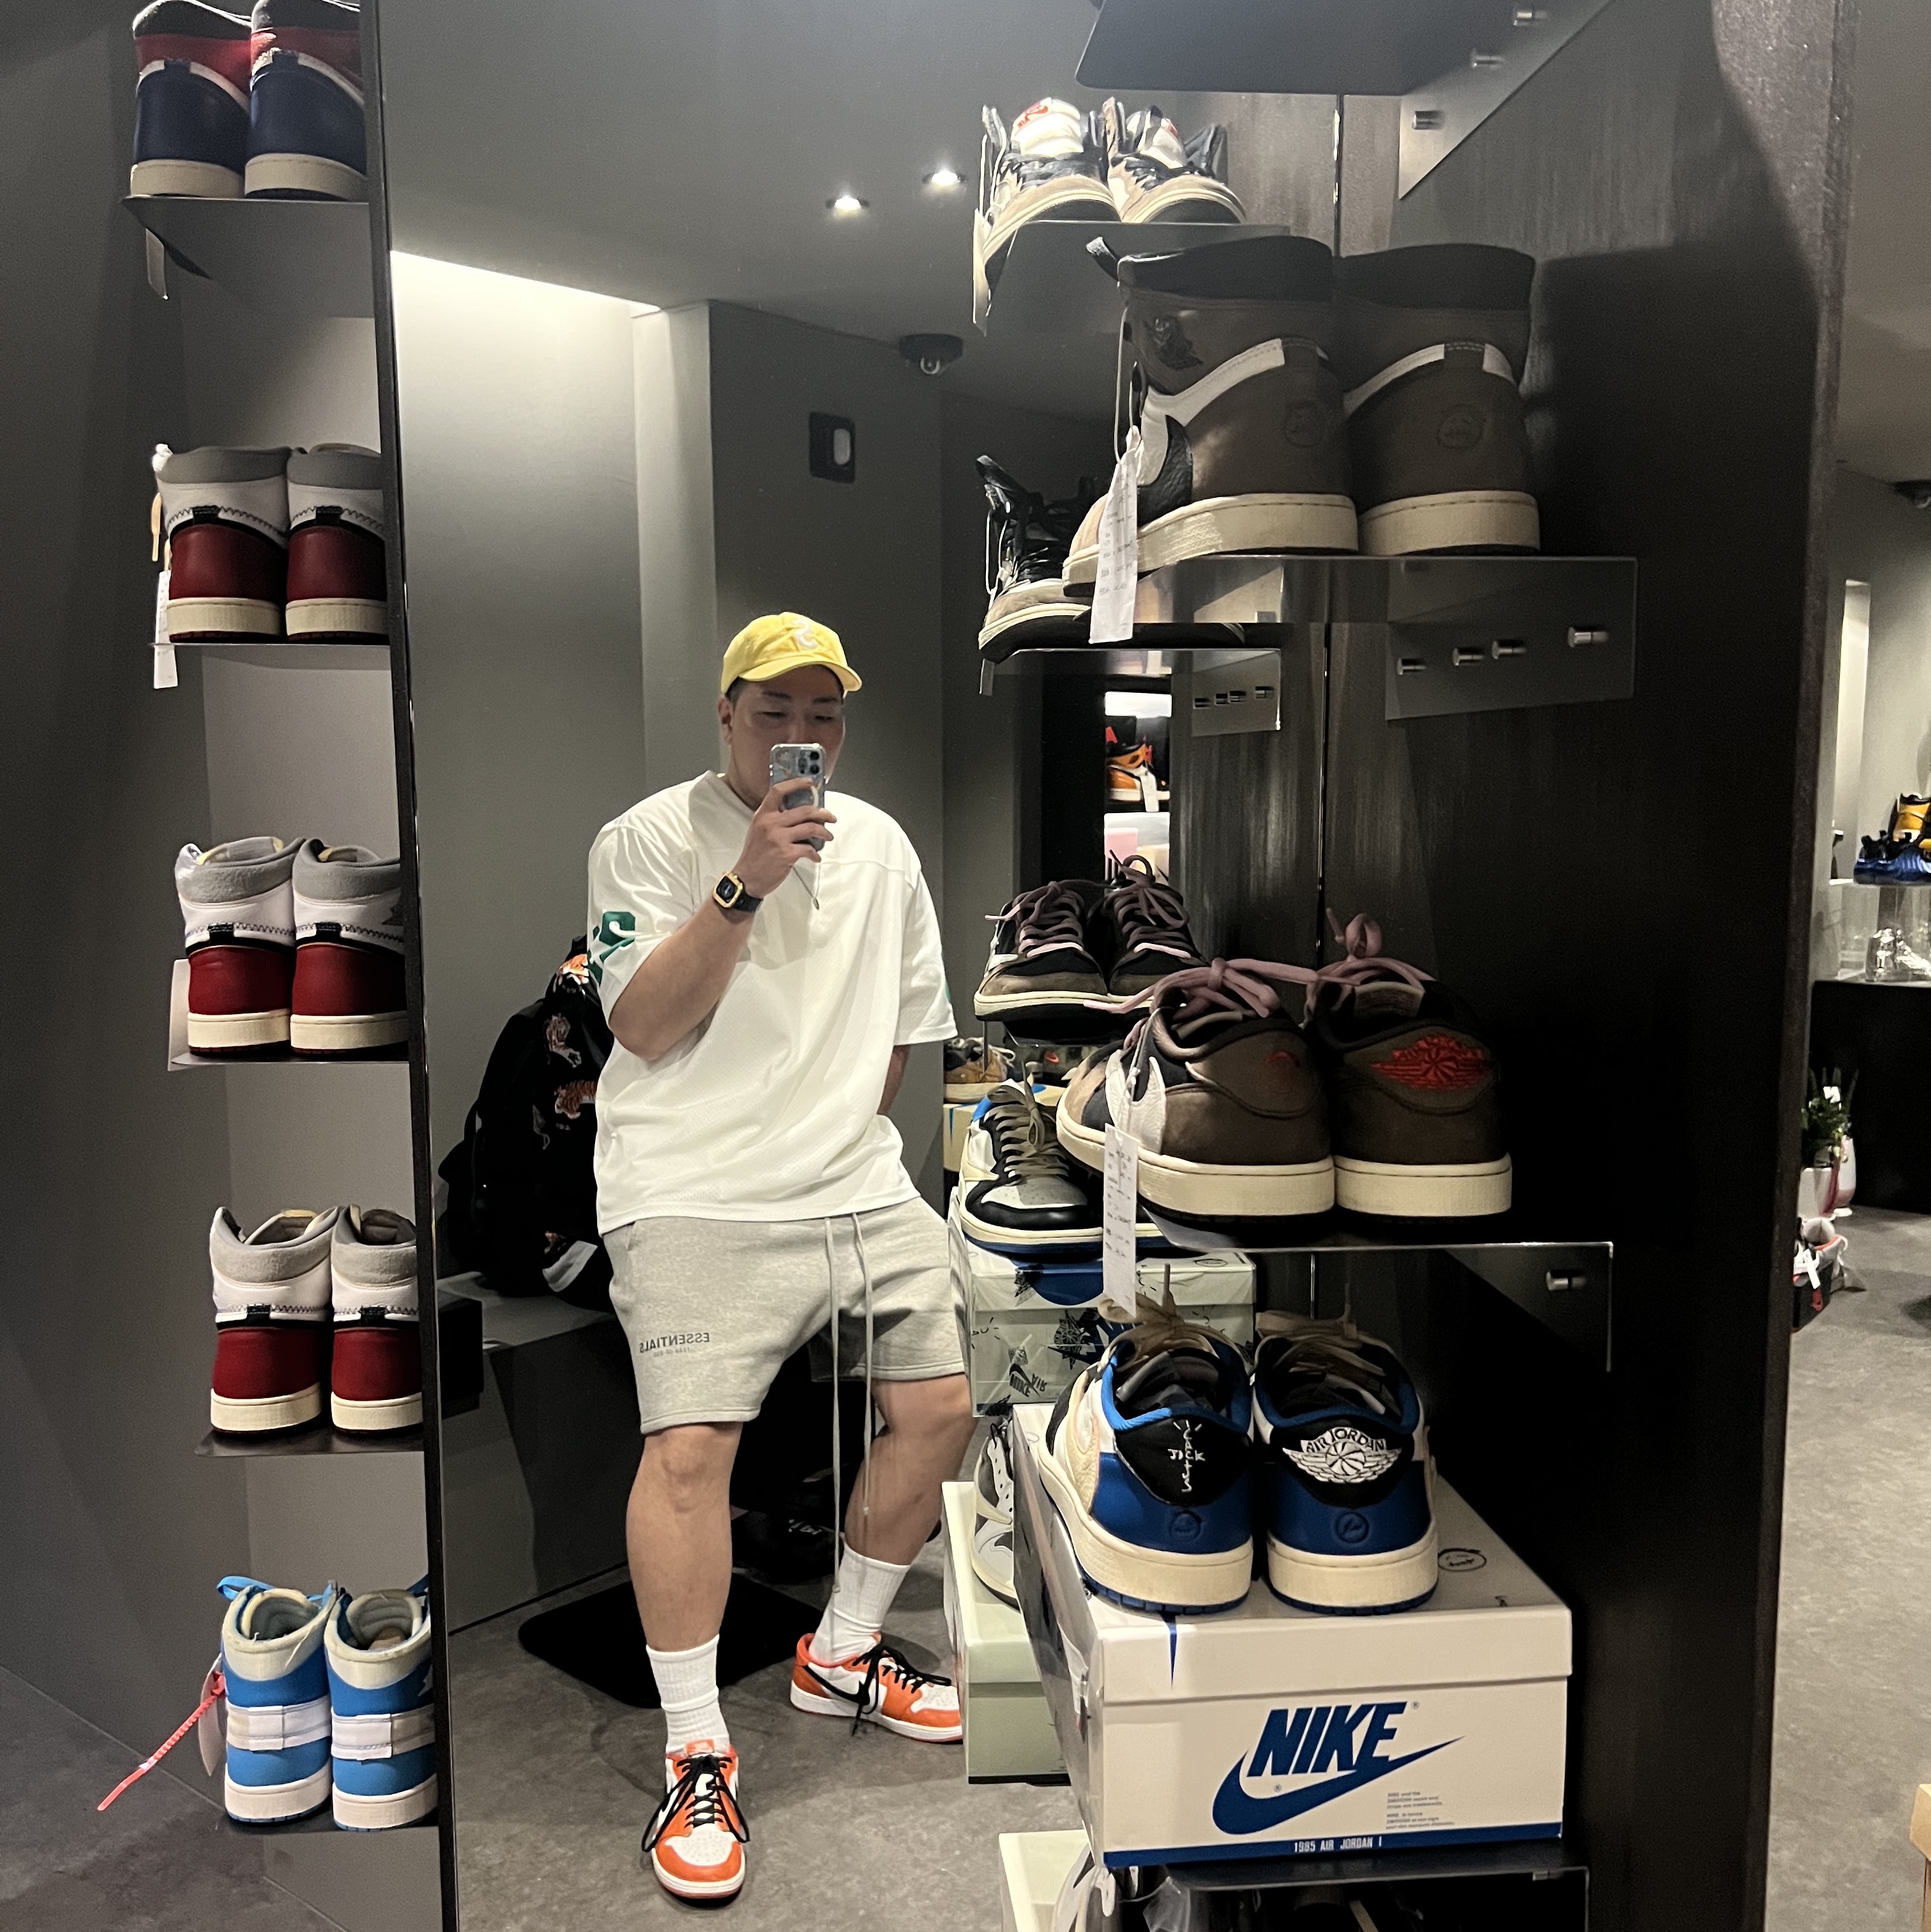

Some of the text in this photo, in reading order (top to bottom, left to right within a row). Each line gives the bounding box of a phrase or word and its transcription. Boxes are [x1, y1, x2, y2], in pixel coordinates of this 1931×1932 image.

[1306, 1428, 1384, 1453] AIR JORDAN
[1246, 1701, 1407, 1777] NIKE
[1294, 1840, 1315, 1852] 1985
[1320, 1839, 1335, 1851] AIR
[1340, 1836, 1373, 1850] JORDAN
